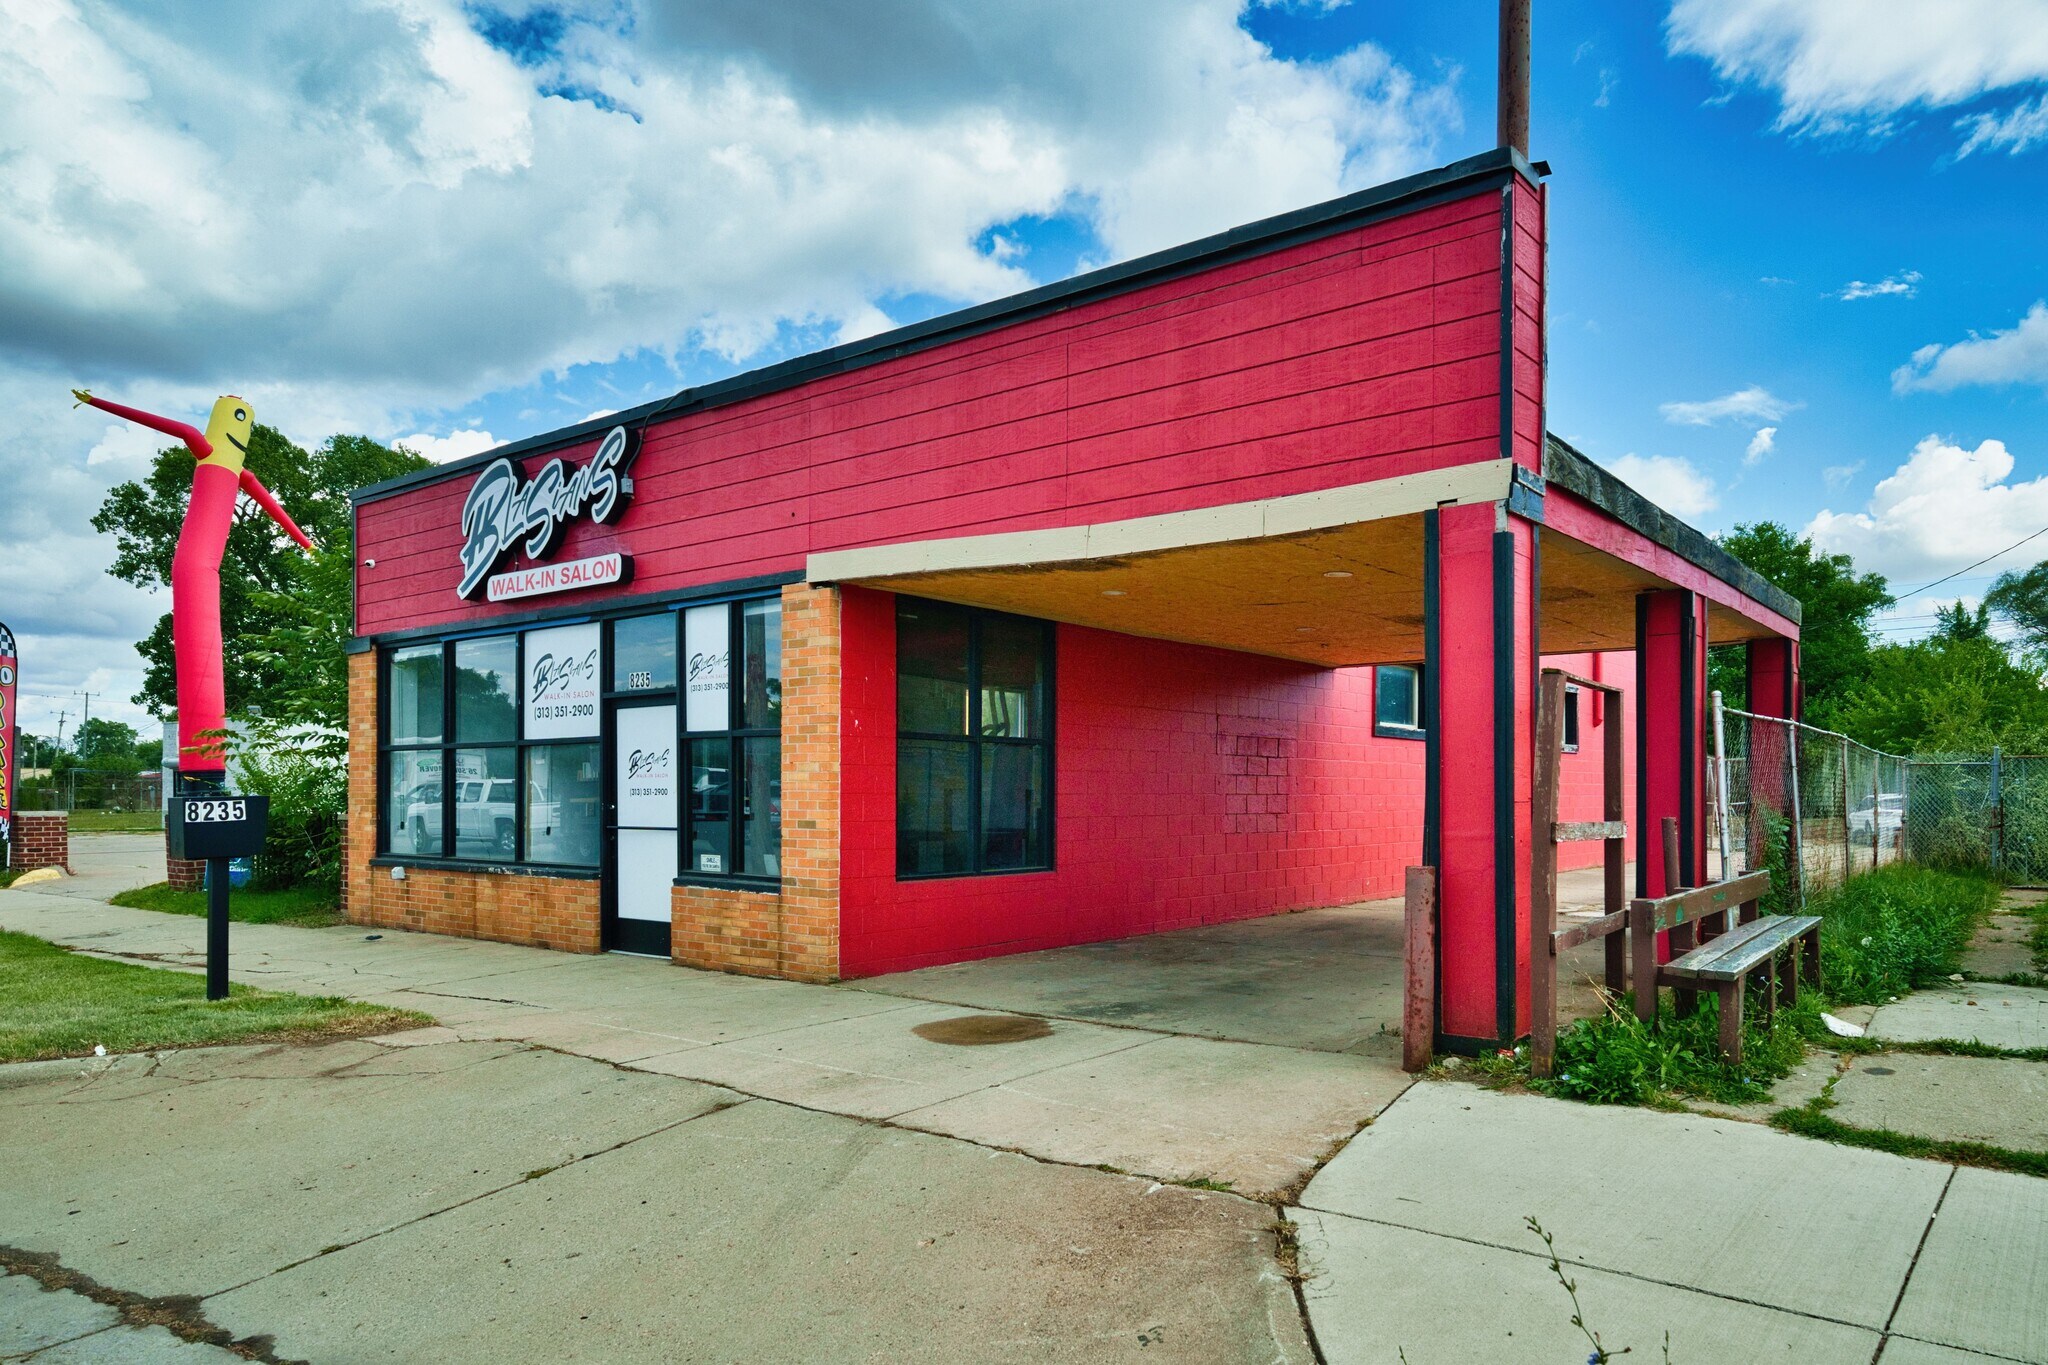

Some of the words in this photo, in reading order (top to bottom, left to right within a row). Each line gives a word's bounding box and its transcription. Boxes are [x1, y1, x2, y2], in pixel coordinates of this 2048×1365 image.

[492, 569, 555, 596] WALK-IN
[560, 558, 617, 585] SALON
[630, 672, 650, 688] 8235
[691, 684, 703, 692] (313)
[544, 692, 571, 700] WALK-IN
[573, 690, 595, 698] SALON
[534, 706, 552, 720] (313)
[554, 704, 594, 717] 351-2900
[630, 788, 642, 797] (313)
[643, 788, 668, 796] 351-2900
[187, 801, 244, 822] 8235
